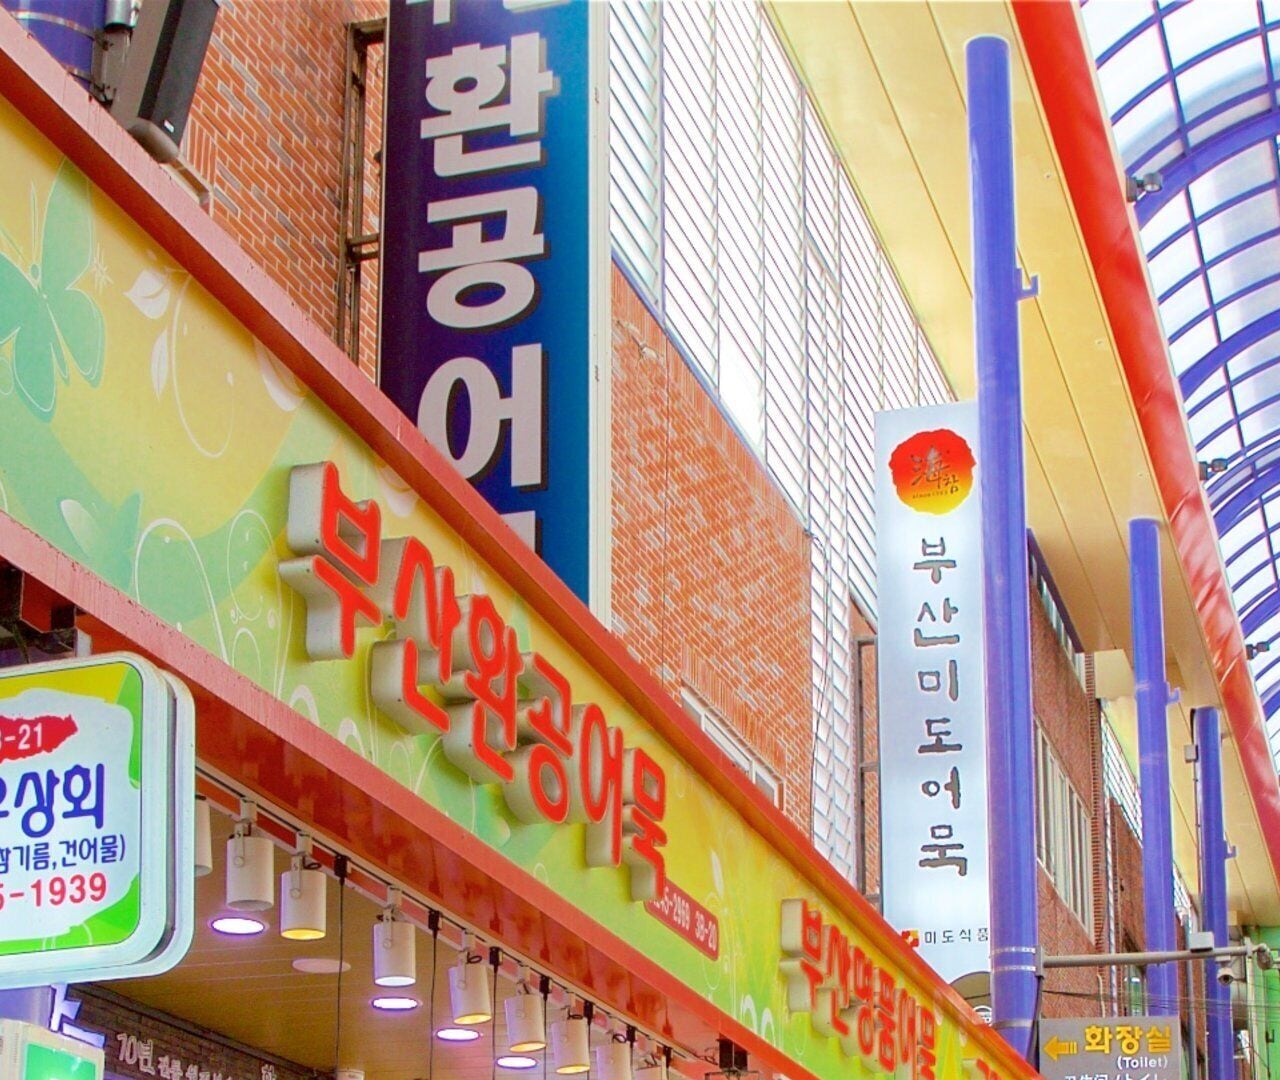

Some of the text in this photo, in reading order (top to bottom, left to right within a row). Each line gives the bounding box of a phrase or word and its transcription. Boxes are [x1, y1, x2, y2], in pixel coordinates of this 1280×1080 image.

[405, 0, 556, 553] 환공어
[913, 537, 968, 878] 부산미도어묵
[924, 928, 988, 945] 미도식품
[1084, 1024, 1172, 1056] 화장실
[1117, 1055, 1168, 1070] (Toilet)
